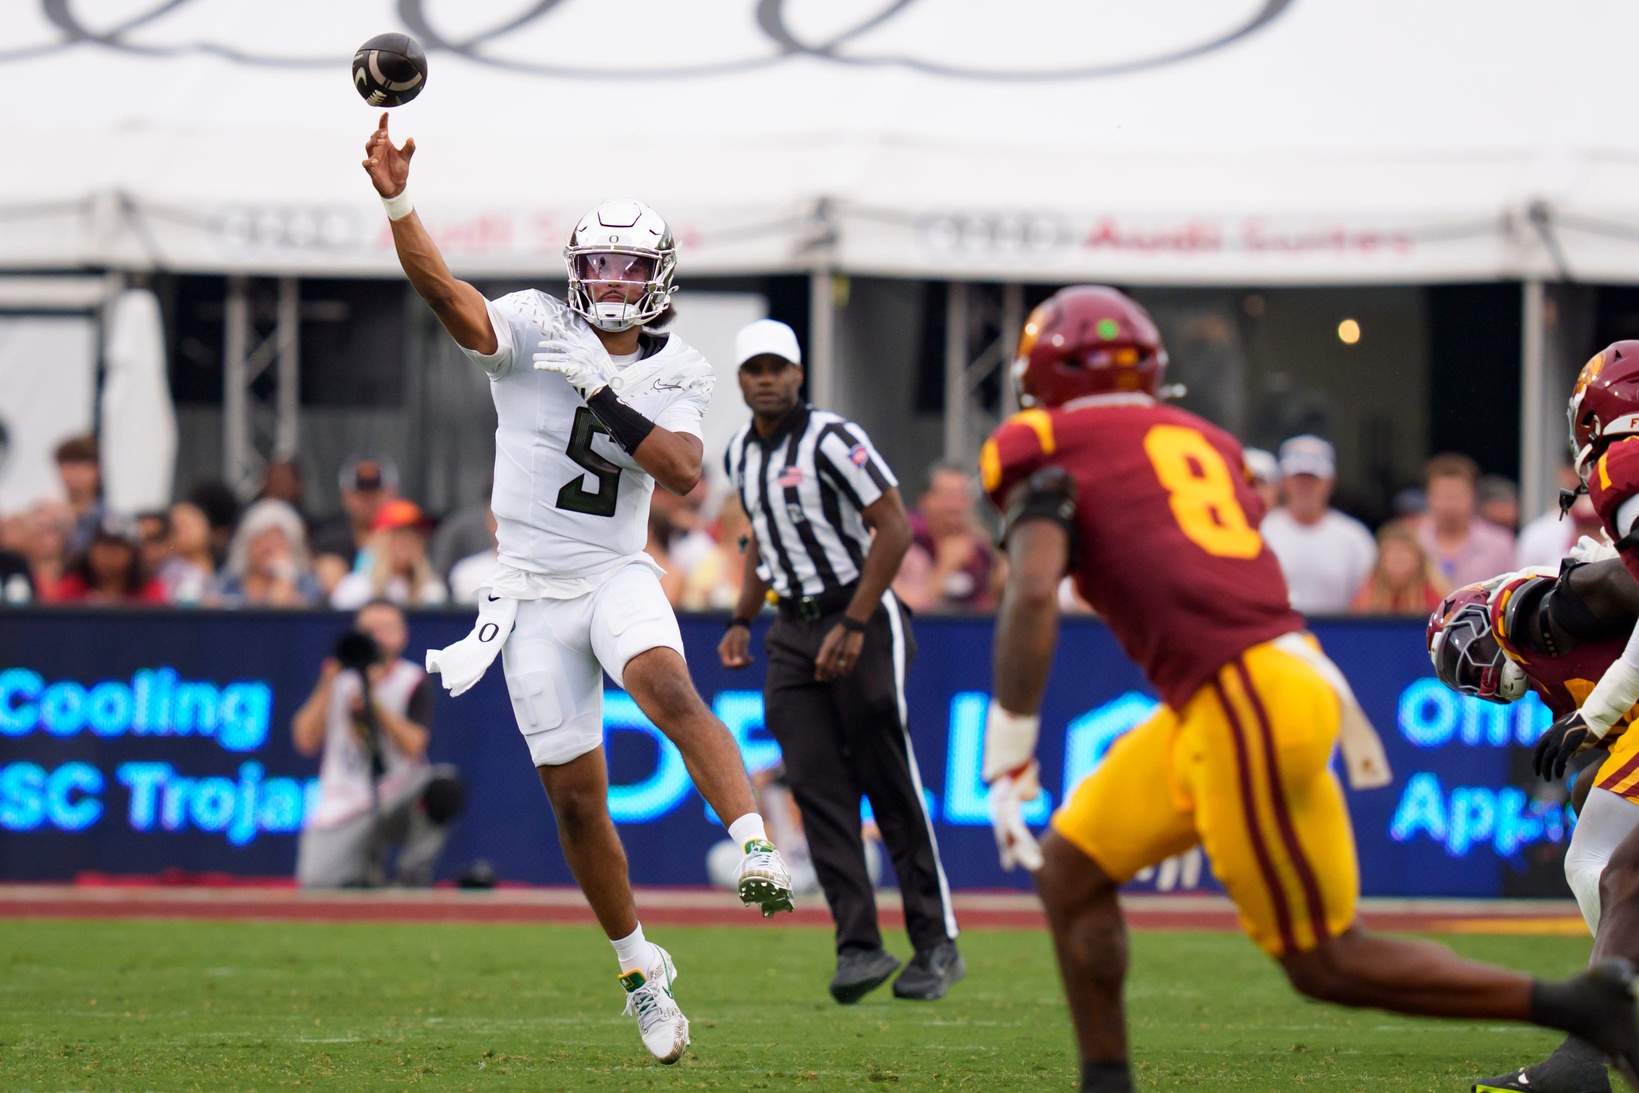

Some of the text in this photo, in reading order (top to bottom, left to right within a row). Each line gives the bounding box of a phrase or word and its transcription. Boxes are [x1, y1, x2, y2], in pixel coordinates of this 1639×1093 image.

[608, 235, 620, 244] O
[609, 376, 625, 390] O
[556, 405, 623, 518] 5
[1143, 424, 1263, 560] 8
[478, 622, 500, 643] O
[0, 666, 271, 752] Cooling
